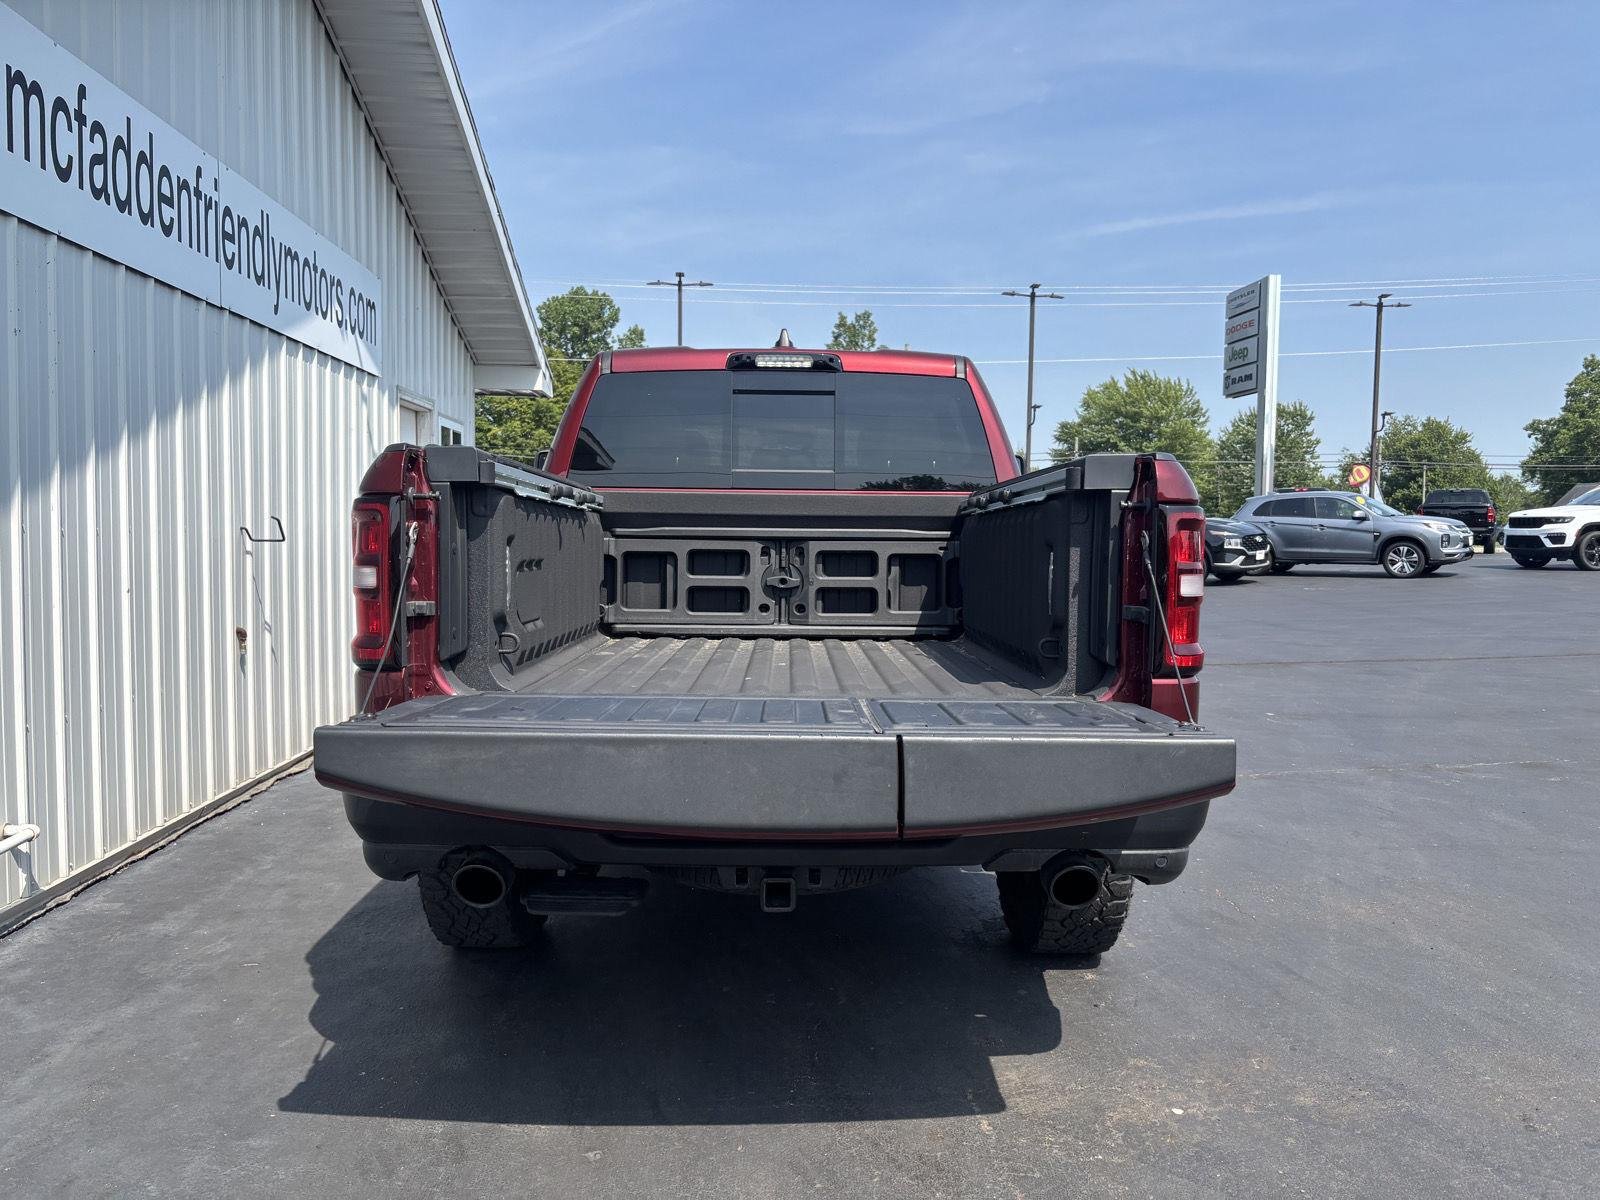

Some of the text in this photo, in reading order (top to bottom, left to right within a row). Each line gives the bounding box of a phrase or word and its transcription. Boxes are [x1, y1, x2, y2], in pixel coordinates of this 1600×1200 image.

[6, 63, 377, 346] mcfaddenfriendlymotors.com
[1226, 319, 1256, 336] DODGE
[1228, 346, 1249, 361] Jeep
[1231, 373, 1253, 386] RAM
